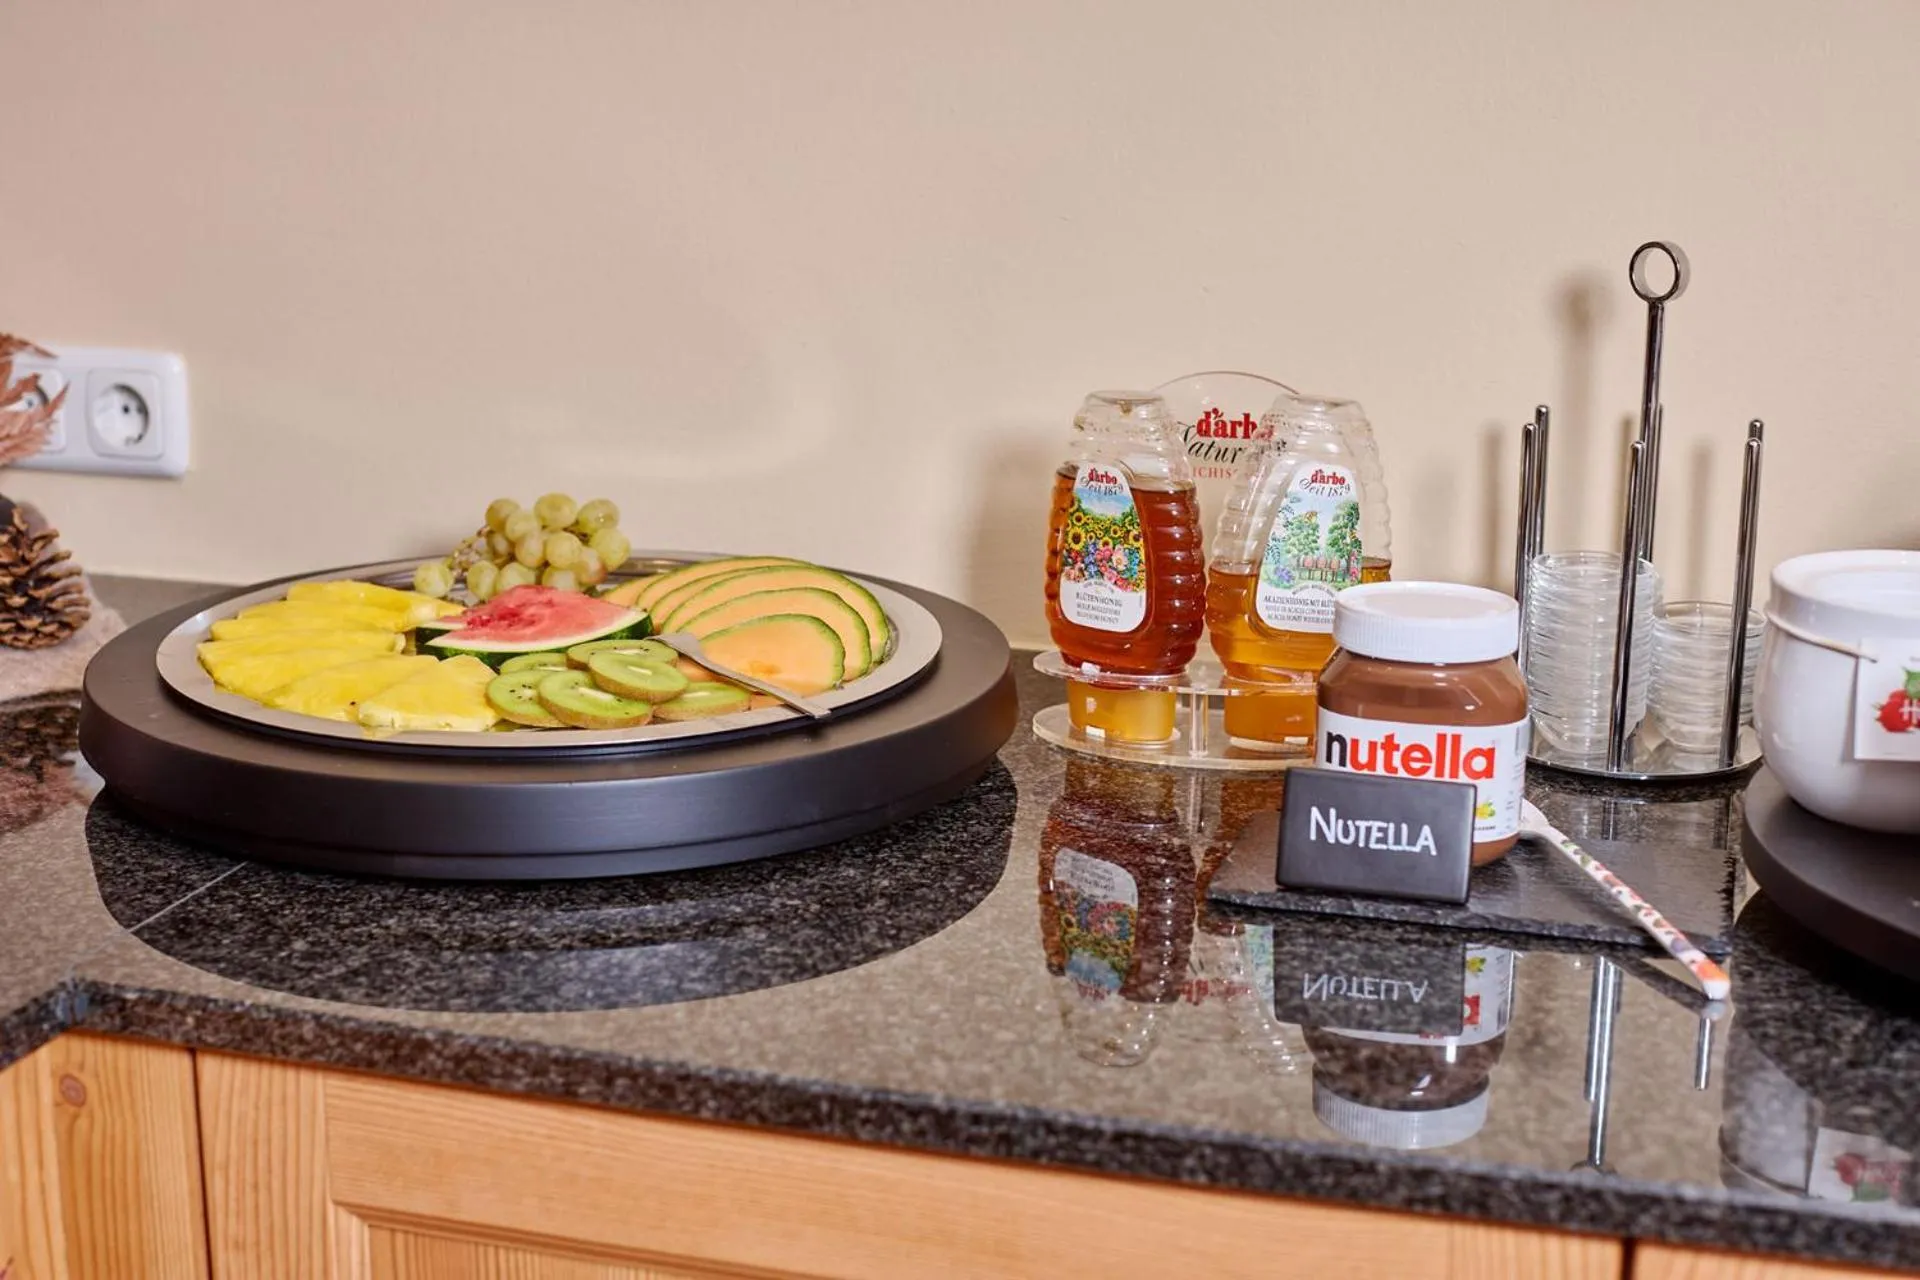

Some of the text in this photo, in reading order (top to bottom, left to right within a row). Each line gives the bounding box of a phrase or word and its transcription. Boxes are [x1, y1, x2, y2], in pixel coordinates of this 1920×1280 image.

[1197, 407, 1260, 439] d'arb
[1326, 731, 1496, 780] nutella
[1310, 806, 1437, 856] NUTELLA
